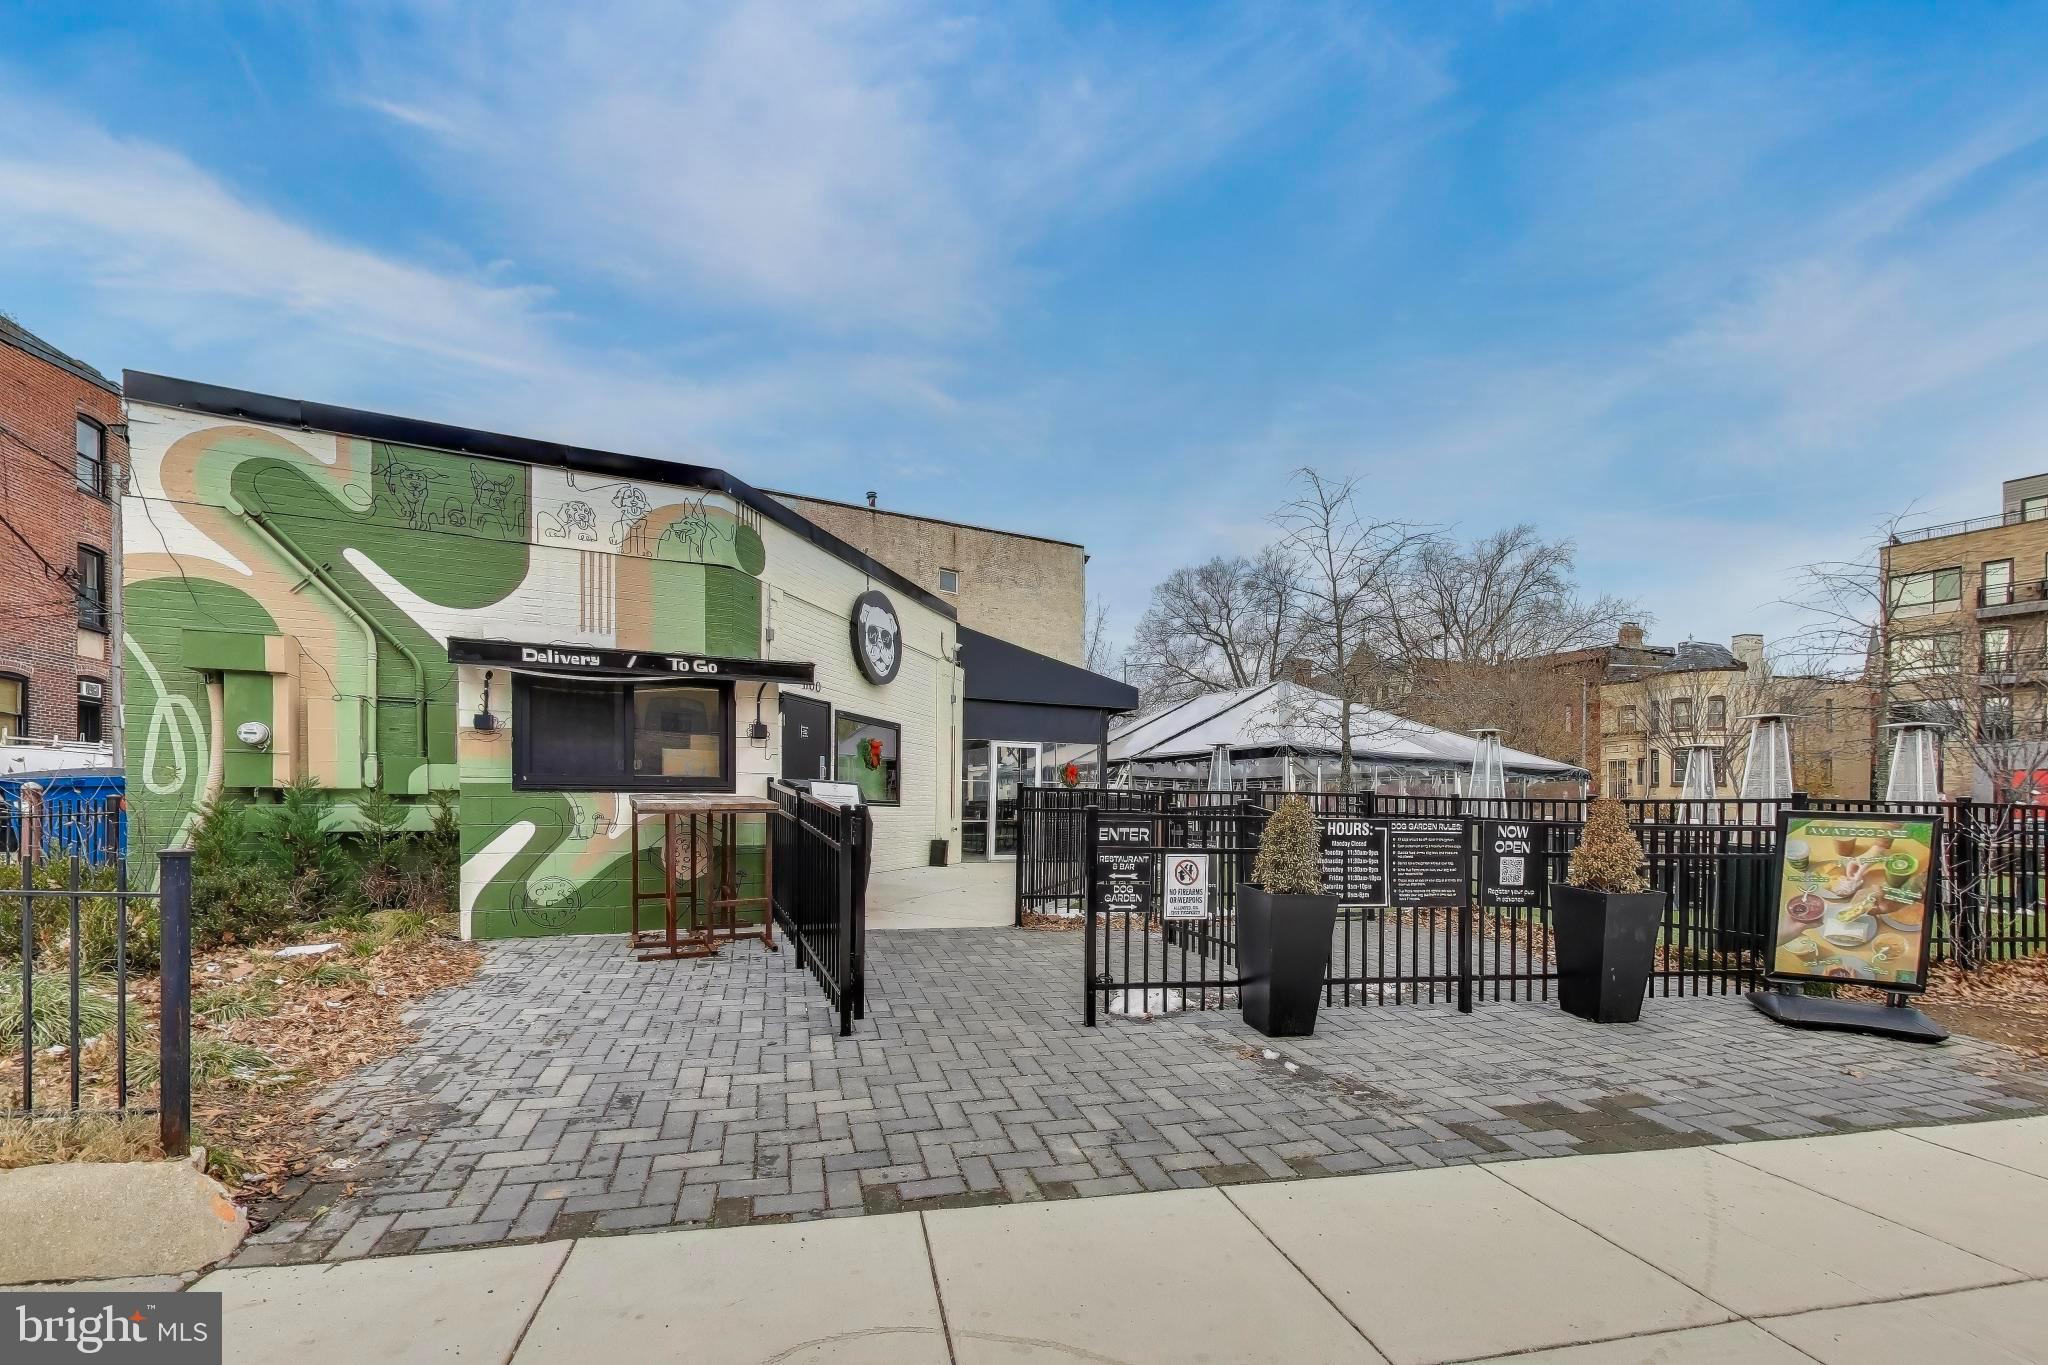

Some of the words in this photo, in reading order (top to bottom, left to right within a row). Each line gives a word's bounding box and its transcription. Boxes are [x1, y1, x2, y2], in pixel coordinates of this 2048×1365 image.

[521, 648, 601, 666] Delivery
[666, 657, 690, 672] To
[693, 660, 718, 673] Go
[1327, 821, 1374, 836] HOURS:
[1391, 822, 1407, 830] DOG
[1408, 823, 1438, 831] GARDEN
[1098, 827, 1150, 841] ENTER
[1497, 824, 1530, 839] NOW
[1494, 840, 1531, 854] OPEN
[1099, 855, 1150, 863] RESTAURANT
[1113, 885, 1134, 894] DOG
[1169, 888, 1177, 896] NO
[1177, 888, 1204, 896] FIREARMS
[1487, 888, 1510, 896] Register
[1104, 894, 1143, 903] GARDEN
[1169, 896, 1177, 904] OR
[1177, 896, 1203, 904] WEAPONS
